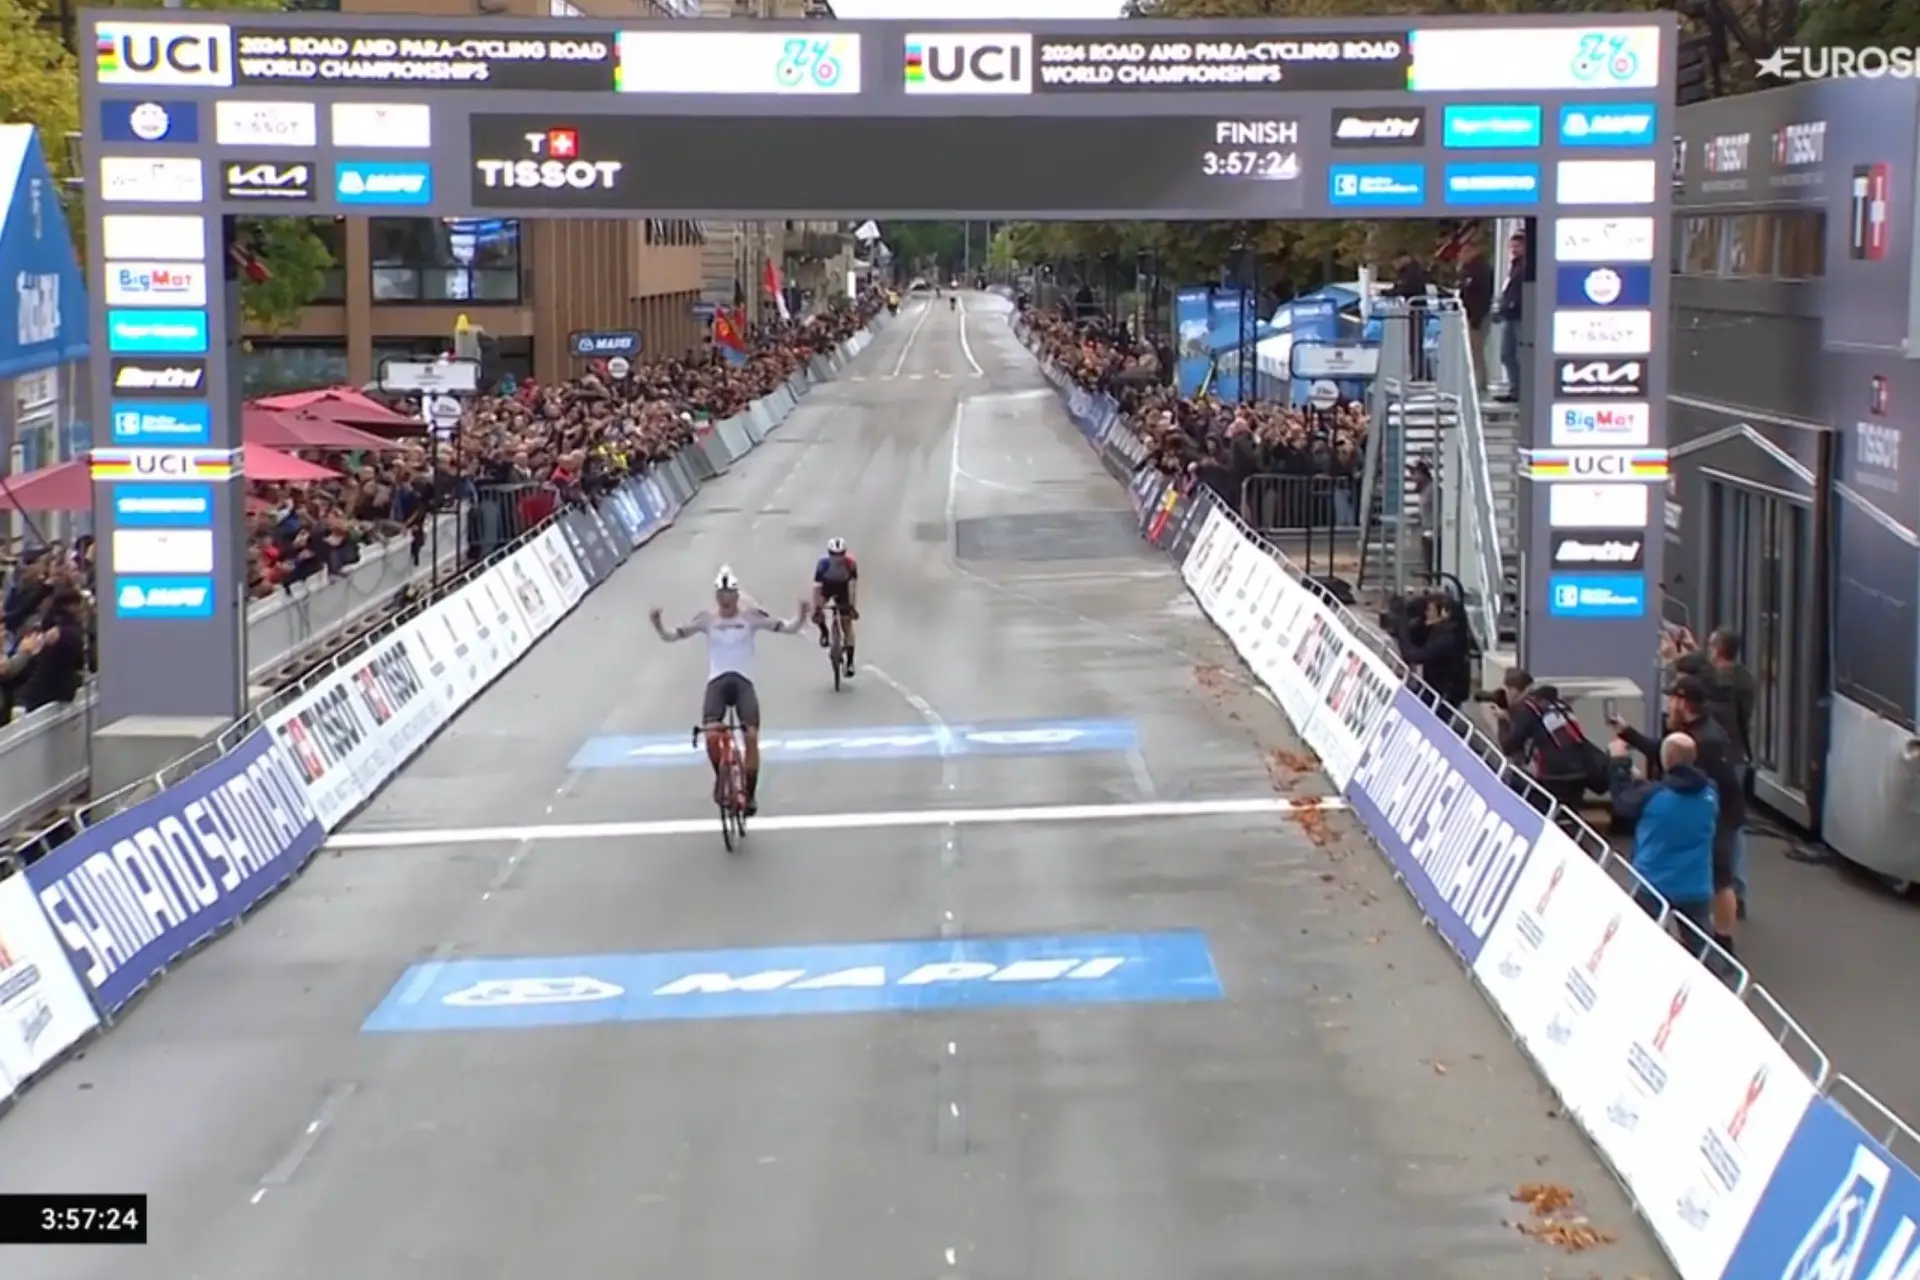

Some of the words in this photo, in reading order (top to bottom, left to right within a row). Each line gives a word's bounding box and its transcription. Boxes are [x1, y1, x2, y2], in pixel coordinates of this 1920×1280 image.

[123, 35, 219, 73] UCI
[289, 37, 349, 56] ROAD
[352, 38, 398, 57] AND
[400, 38, 546, 60] PARA-CYCLING
[550, 40, 608, 59] ROAD
[1041, 44, 1086, 61] 2024
[1089, 42, 1145, 61] ROAD
[1149, 43, 1192, 61] AND
[1195, 41, 1340, 61] PARA-CYCLING
[1343, 41, 1400, 60] ROAD
[240, 58, 317, 78] WORLD
[319, 60, 489, 81] CHAMPIONSHIPS
[928, 44, 1021, 83] UCI
[1041, 65, 1114, 84] WORLD
[1117, 64, 1283, 84] CHAMPIONSHIPS
[1216, 121, 1298, 144] FINISH
[476, 160, 622, 189] TISSOT
[1203, 152, 1299, 177] 3:57:24
[136, 454, 187, 474] UCI
[1574, 456, 1625, 474] UCI
[297, 683, 367, 770] TISSOT
[1354, 707, 1450, 845] SHIMANO
[1410, 768, 1531, 939] SHIMANO
[40, 815, 218, 988] SHIMANO
[652, 957, 1127, 996] MAPEI
